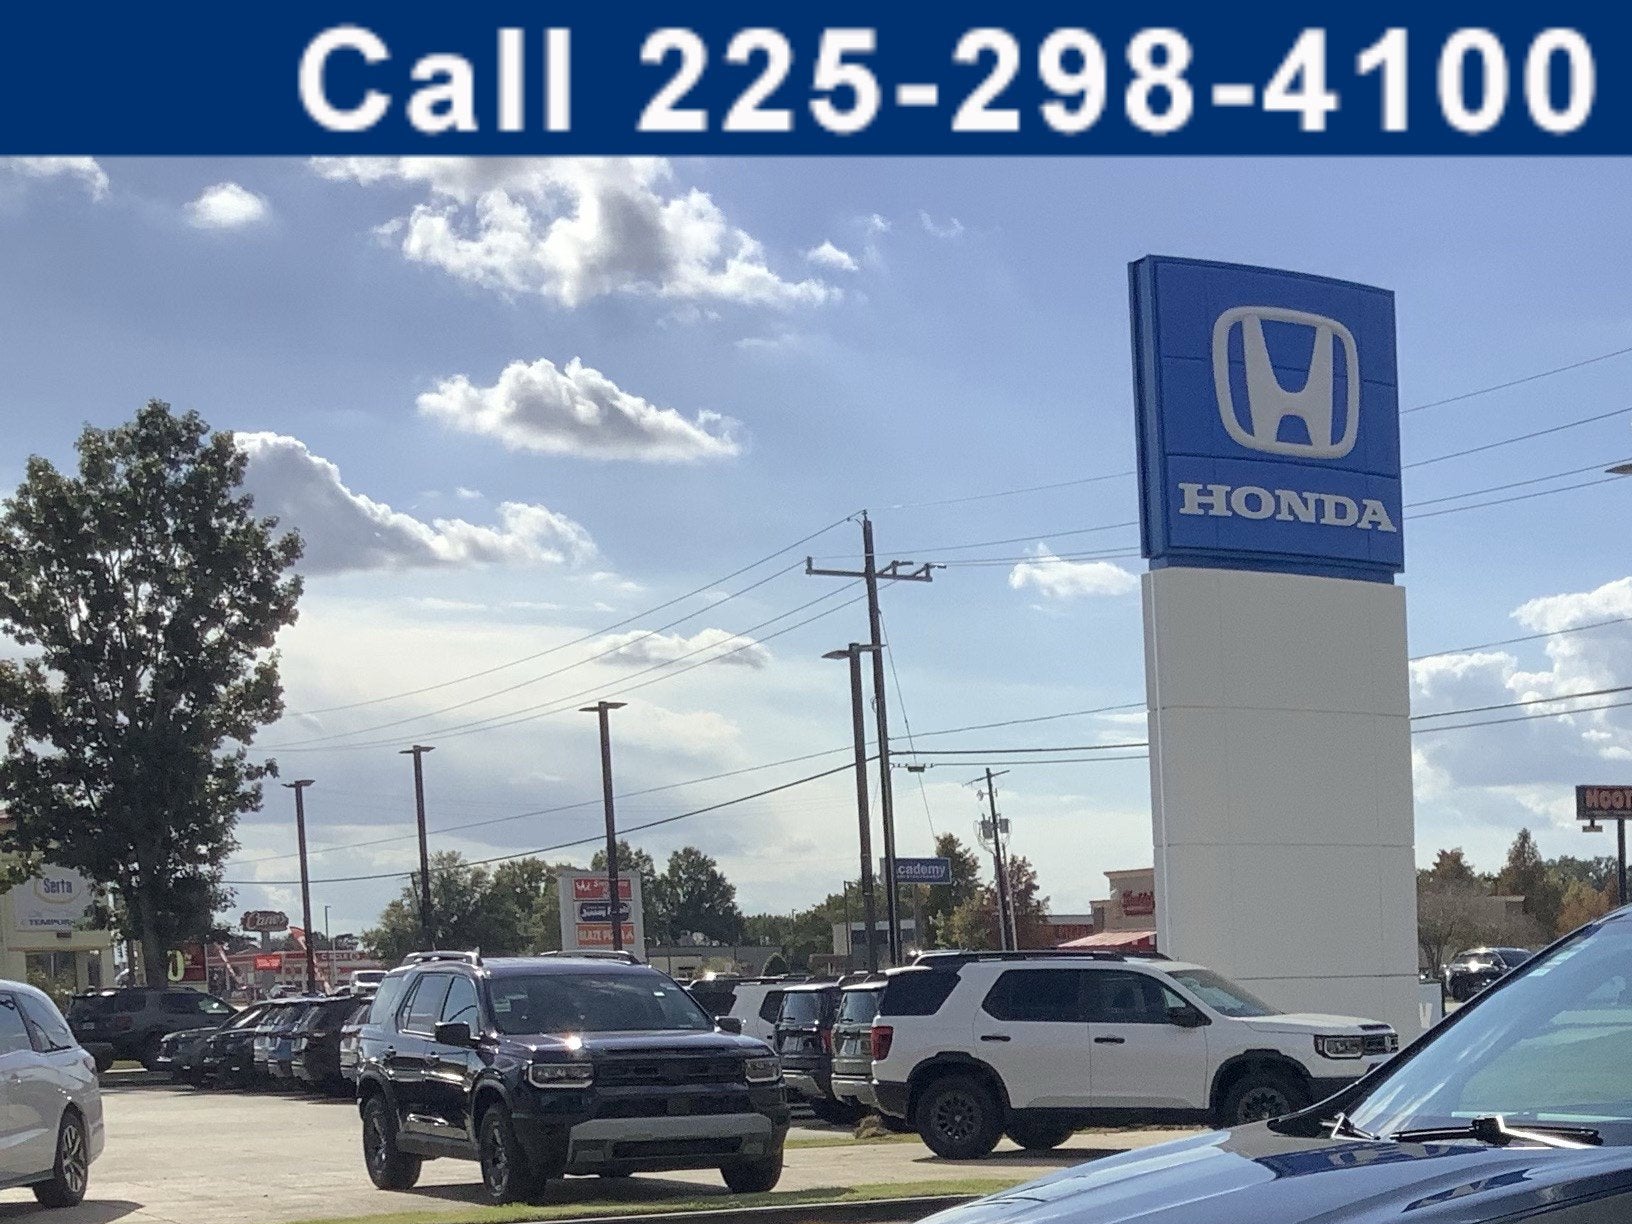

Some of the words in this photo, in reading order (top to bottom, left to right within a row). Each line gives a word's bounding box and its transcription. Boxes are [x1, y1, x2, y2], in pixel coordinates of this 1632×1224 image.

[1178, 482, 1397, 533] HONDA
[897, 863, 946, 878] cademy
[43, 877, 73, 894] Serta
